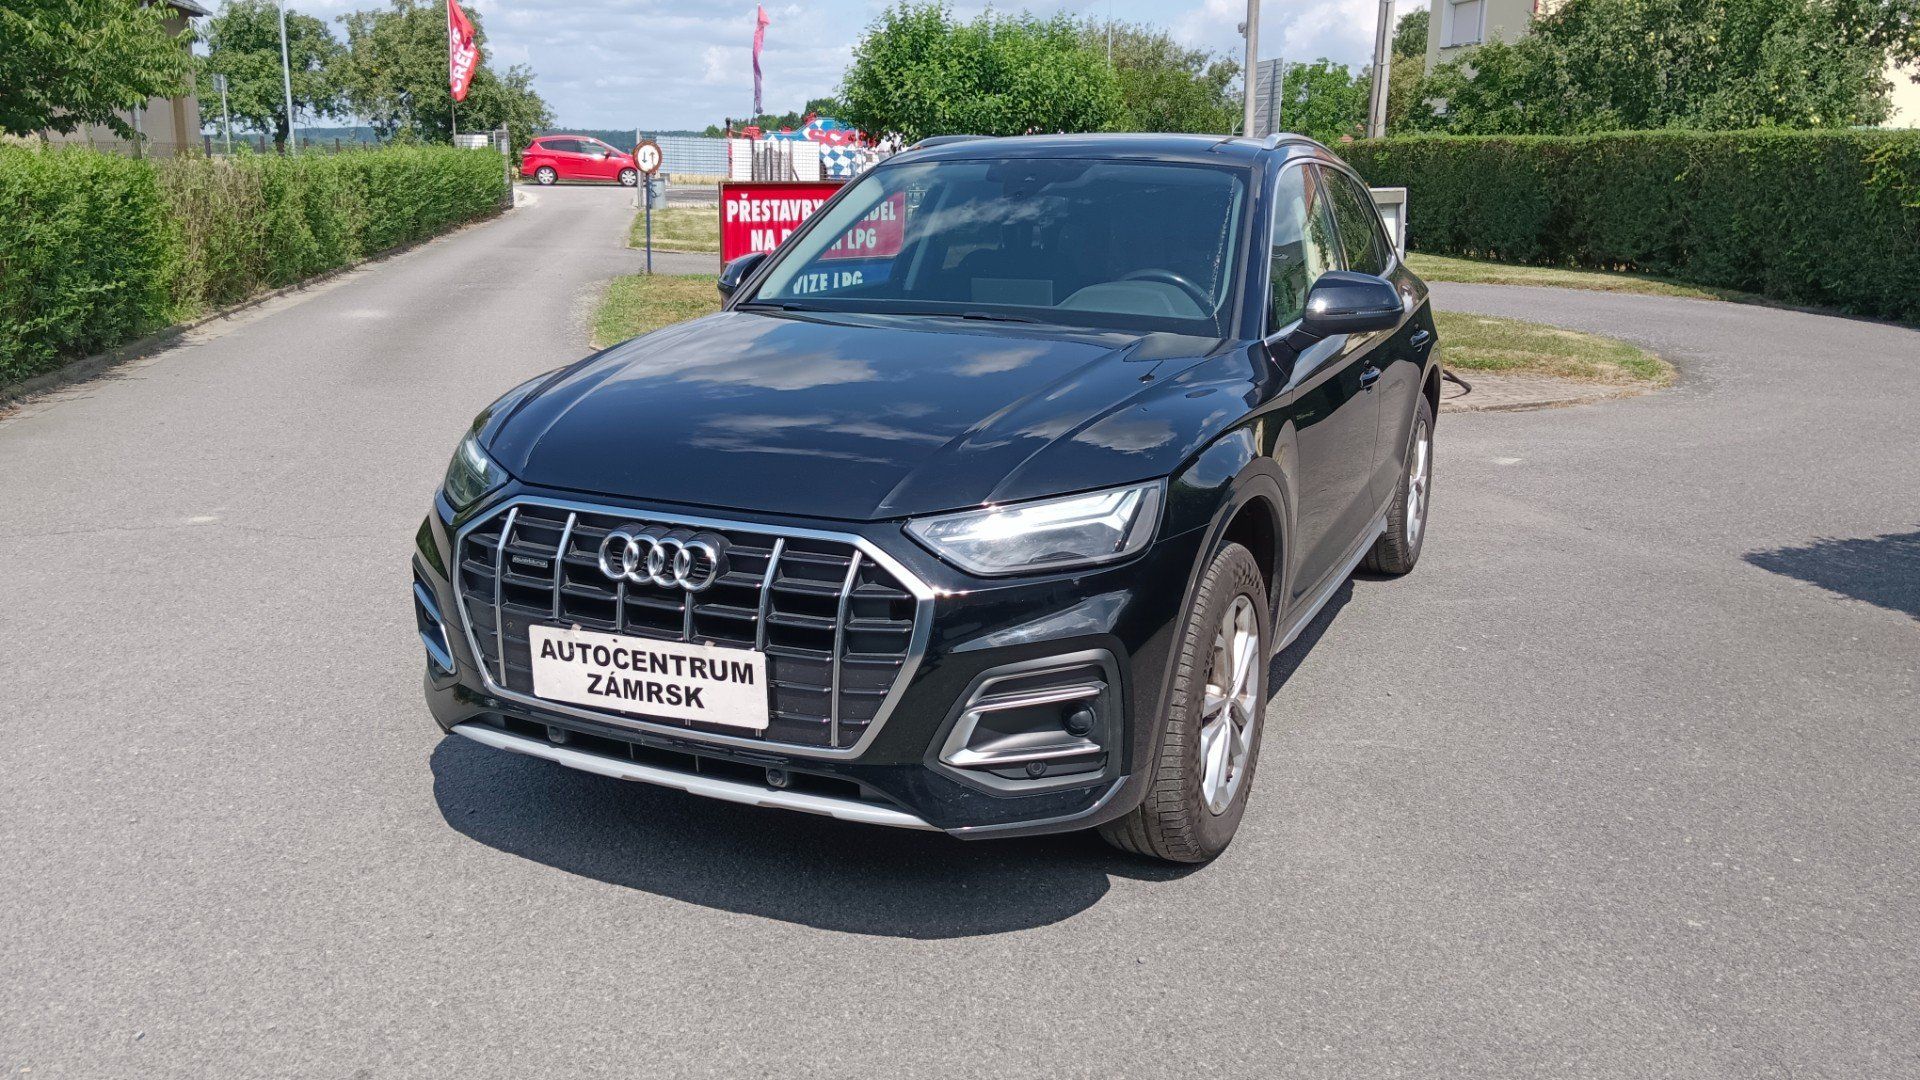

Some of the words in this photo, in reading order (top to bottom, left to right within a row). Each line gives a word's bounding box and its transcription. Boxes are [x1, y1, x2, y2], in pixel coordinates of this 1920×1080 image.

[750, 229, 776, 251] NA
[847, 228, 877, 249] LPG
[540, 638, 754, 685] AUTOCENTRUM
[587, 673, 705, 709] ZÁMRSK
